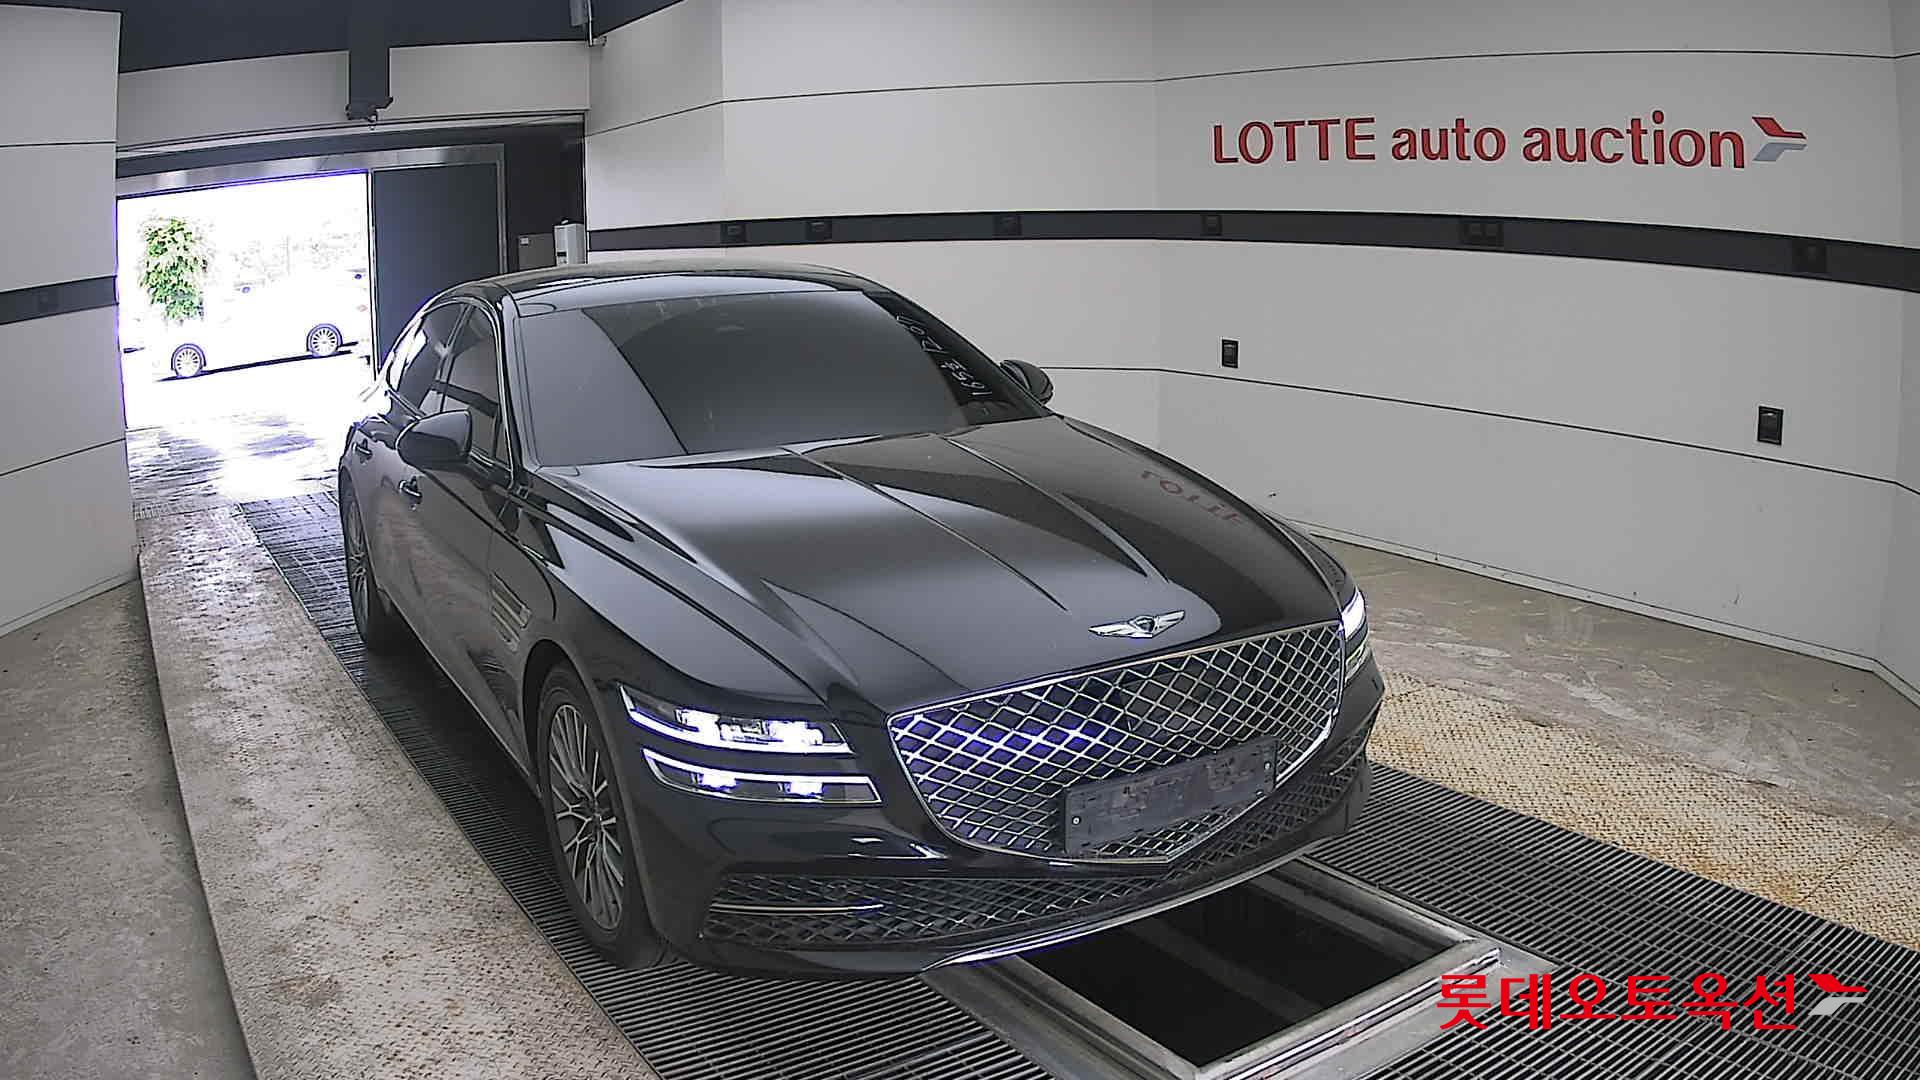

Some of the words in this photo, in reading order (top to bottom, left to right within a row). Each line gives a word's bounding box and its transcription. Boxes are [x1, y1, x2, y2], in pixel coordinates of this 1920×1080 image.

[1214, 118, 1375, 163] LOTTE
[1391, 118, 1507, 161] auto
[1522, 111, 1745, 168] auction
